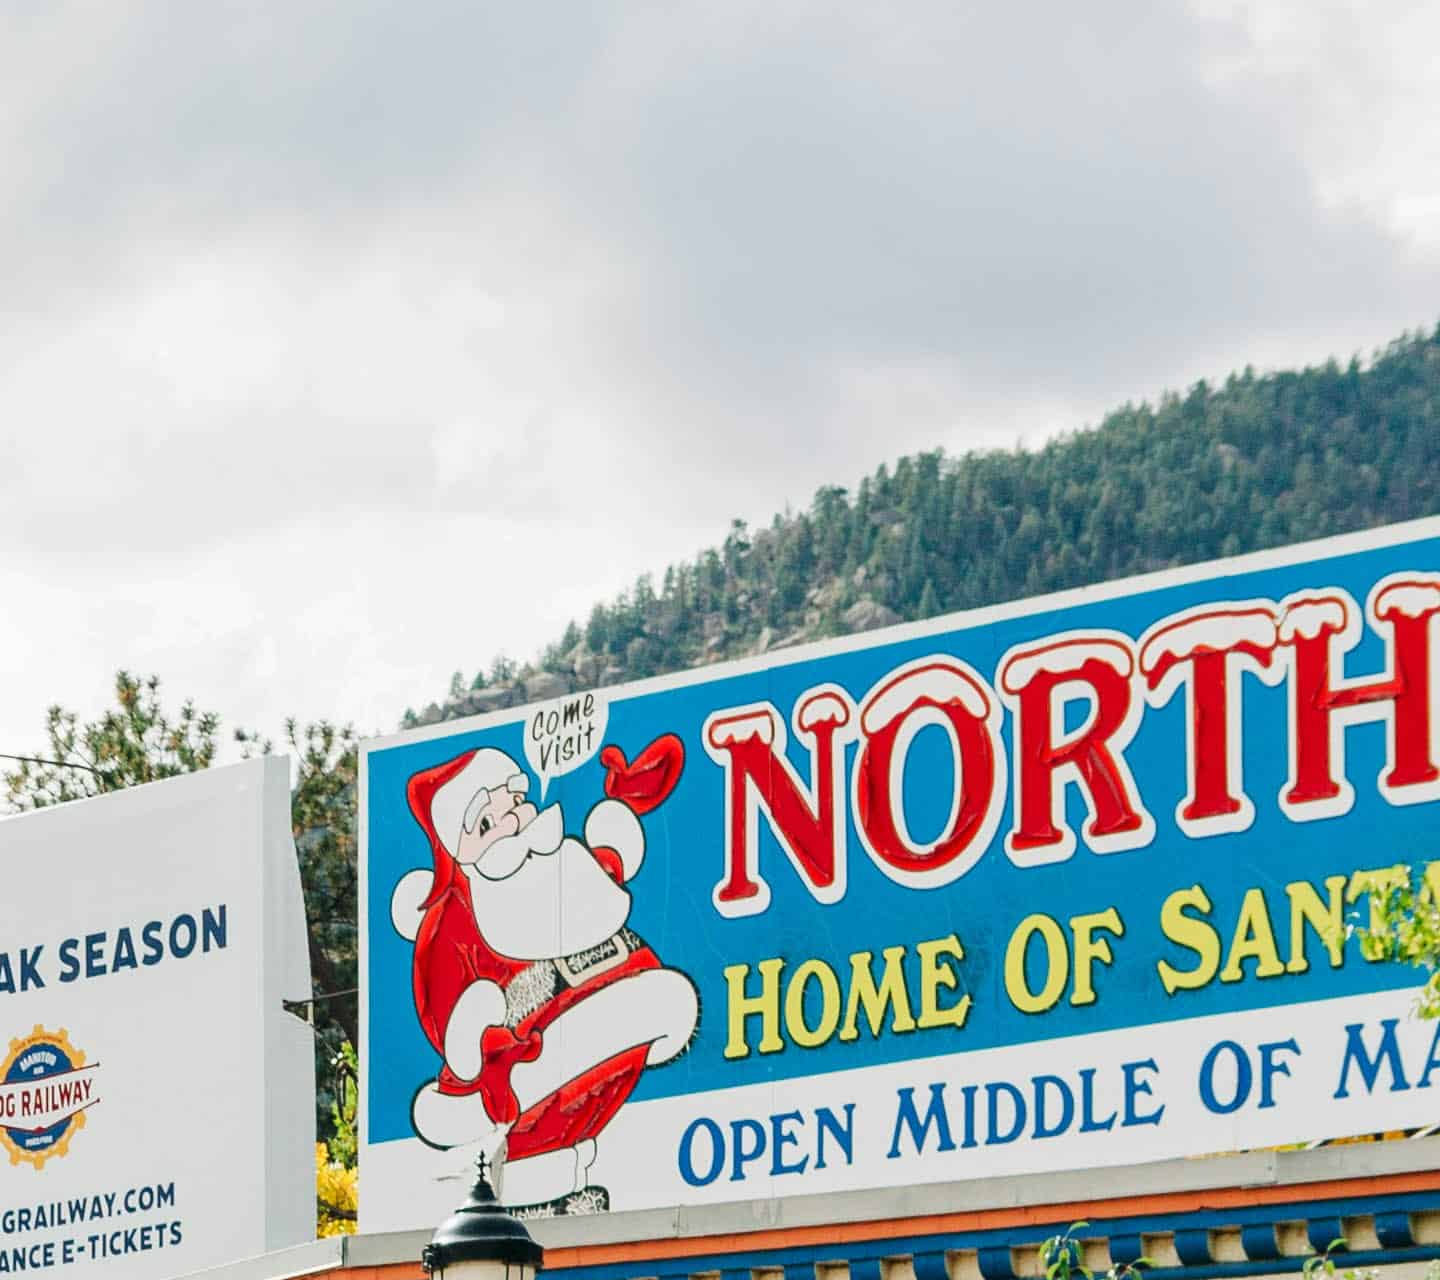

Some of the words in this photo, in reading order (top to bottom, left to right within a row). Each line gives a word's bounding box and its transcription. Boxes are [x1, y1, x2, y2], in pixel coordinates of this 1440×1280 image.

[705, 572, 1440, 917] NORTH
[58, 903, 229, 982] SEASON
[724, 935, 973, 1060] HOME
[1004, 906, 1124, 1015] OF
[21, 1079, 92, 1117] RAILWAY
[678, 1103, 855, 1187] OPEN
[887, 1058, 1165, 1160] MIDDLE
[1199, 1038, 1301, 1115] OF
[61, 1220, 183, 1266] E-TICKETS
